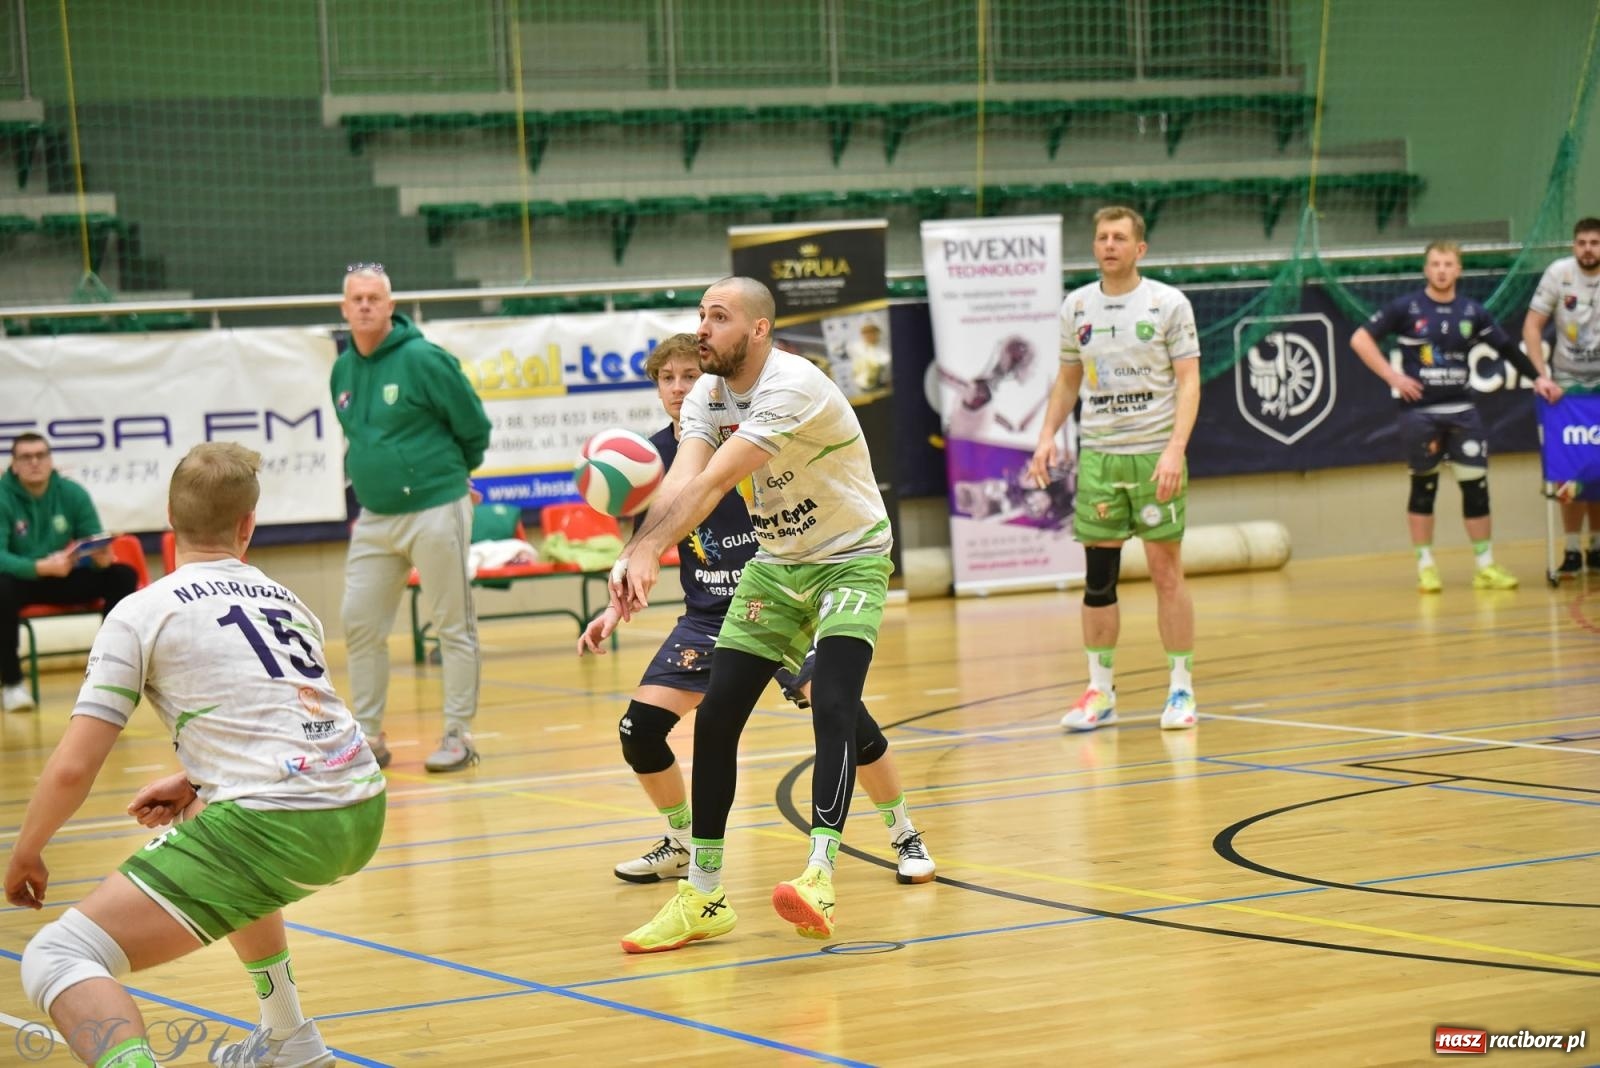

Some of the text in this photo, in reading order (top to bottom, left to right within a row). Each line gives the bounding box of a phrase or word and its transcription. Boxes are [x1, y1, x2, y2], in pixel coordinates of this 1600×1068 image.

[943, 236, 1047, 262] PIVEXIN
[947, 262, 1048, 279] TECHNOLOGY
[1114, 367, 1153, 377] GUARD
[204, 408, 323, 442] FM
[1167, 502, 1177, 524] 1
[836, 587, 867, 615] 77
[216, 605, 325, 680] 15
